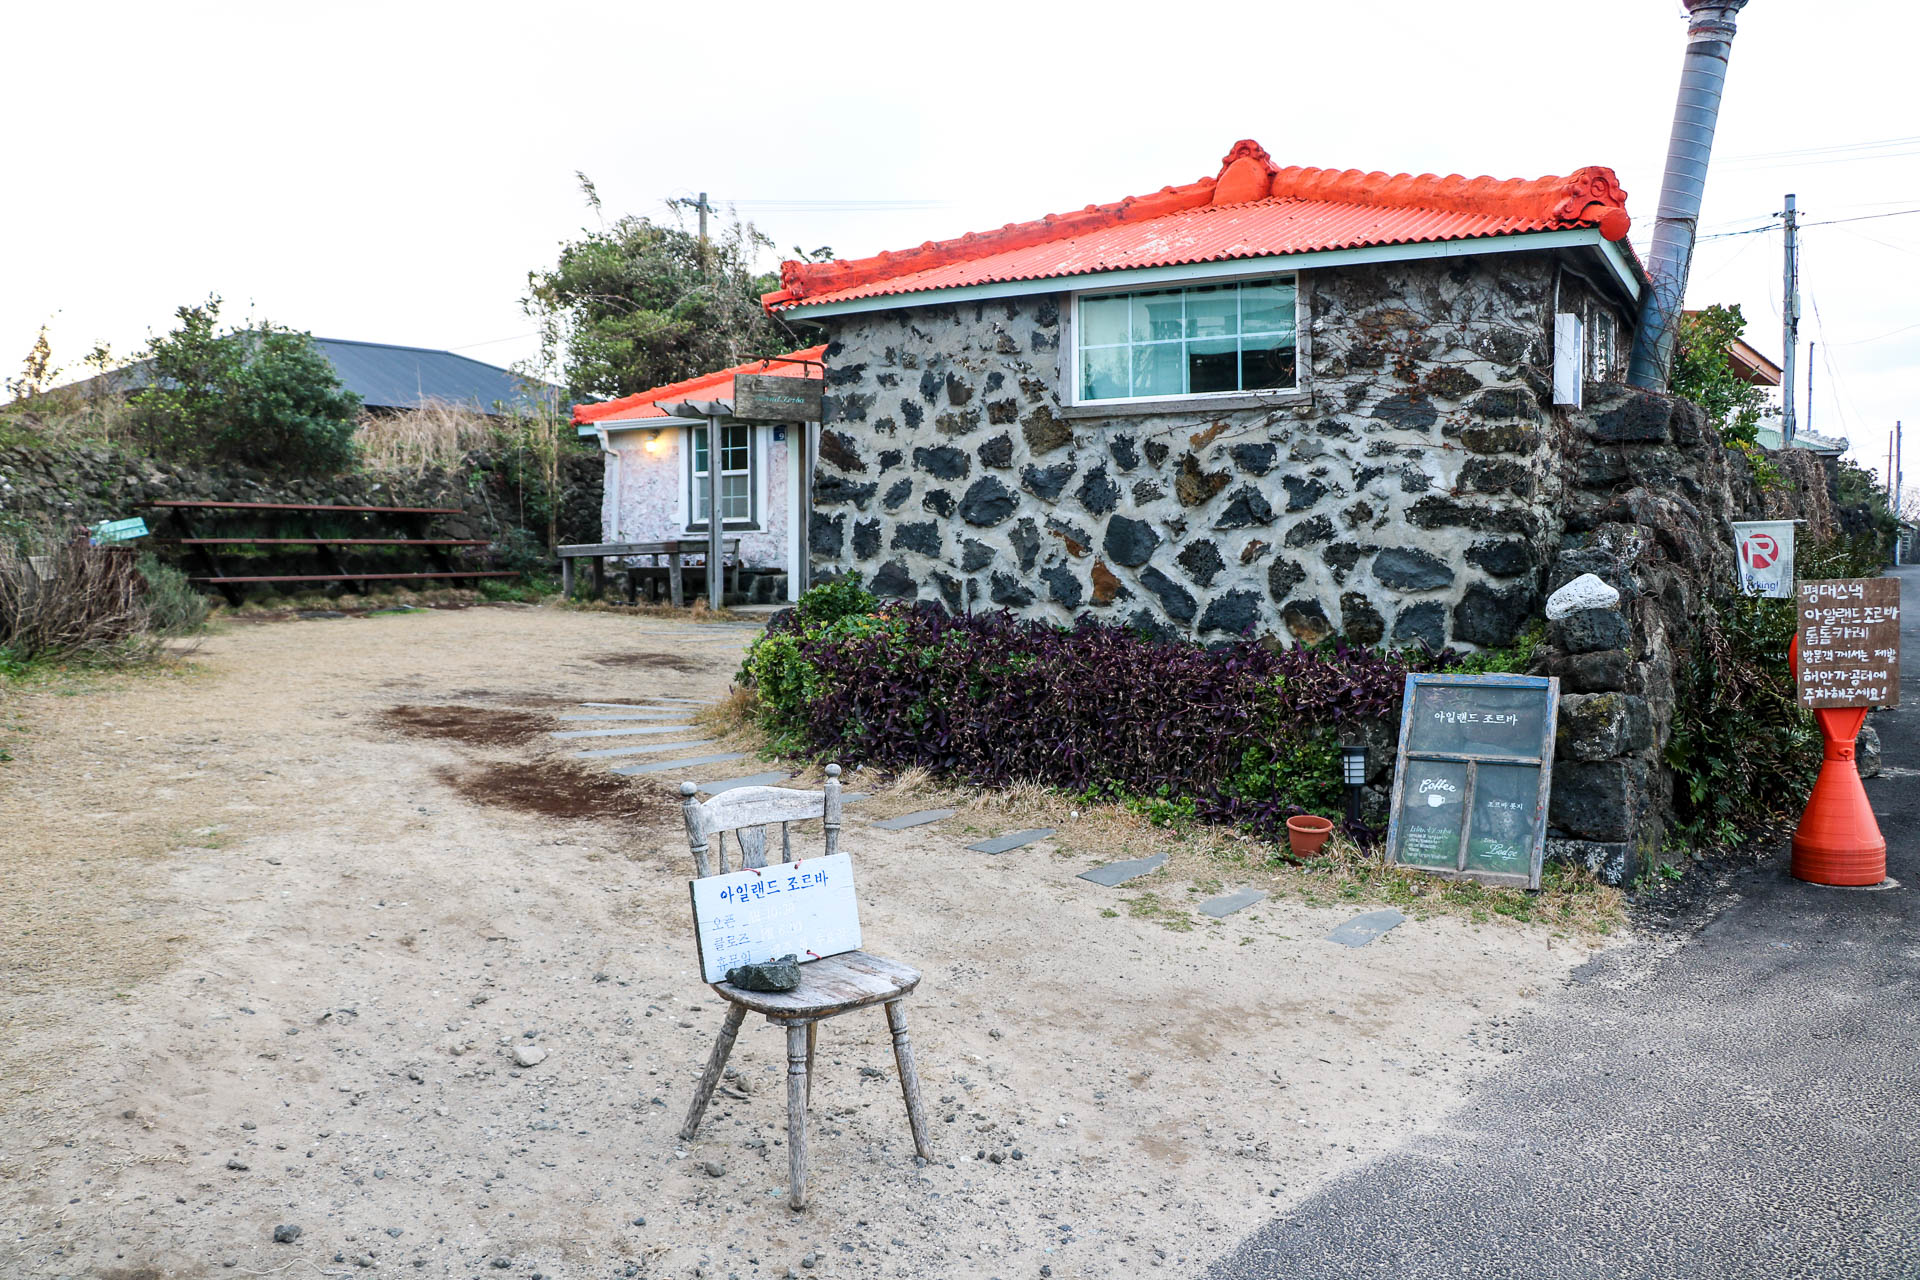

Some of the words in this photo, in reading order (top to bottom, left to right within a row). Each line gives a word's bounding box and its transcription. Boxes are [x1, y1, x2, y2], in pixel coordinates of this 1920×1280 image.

[1747, 580, 1779, 592] rking!
[1802, 583, 1864, 604] 평대스낵
[1804, 607, 1862, 626] 아일랜드
[1863, 606, 1900, 624] 조르바
[1805, 625, 1869, 645] 톰톰카레
[1874, 647, 1896, 664] 제발
[1434, 711, 1479, 724] 아일랜드
[1483, 713, 1519, 726] 조르바
[1419, 778, 1457, 794] Coffee
[720, 880, 780, 904] 아일랜드
[787, 870, 829, 892] 조르바
